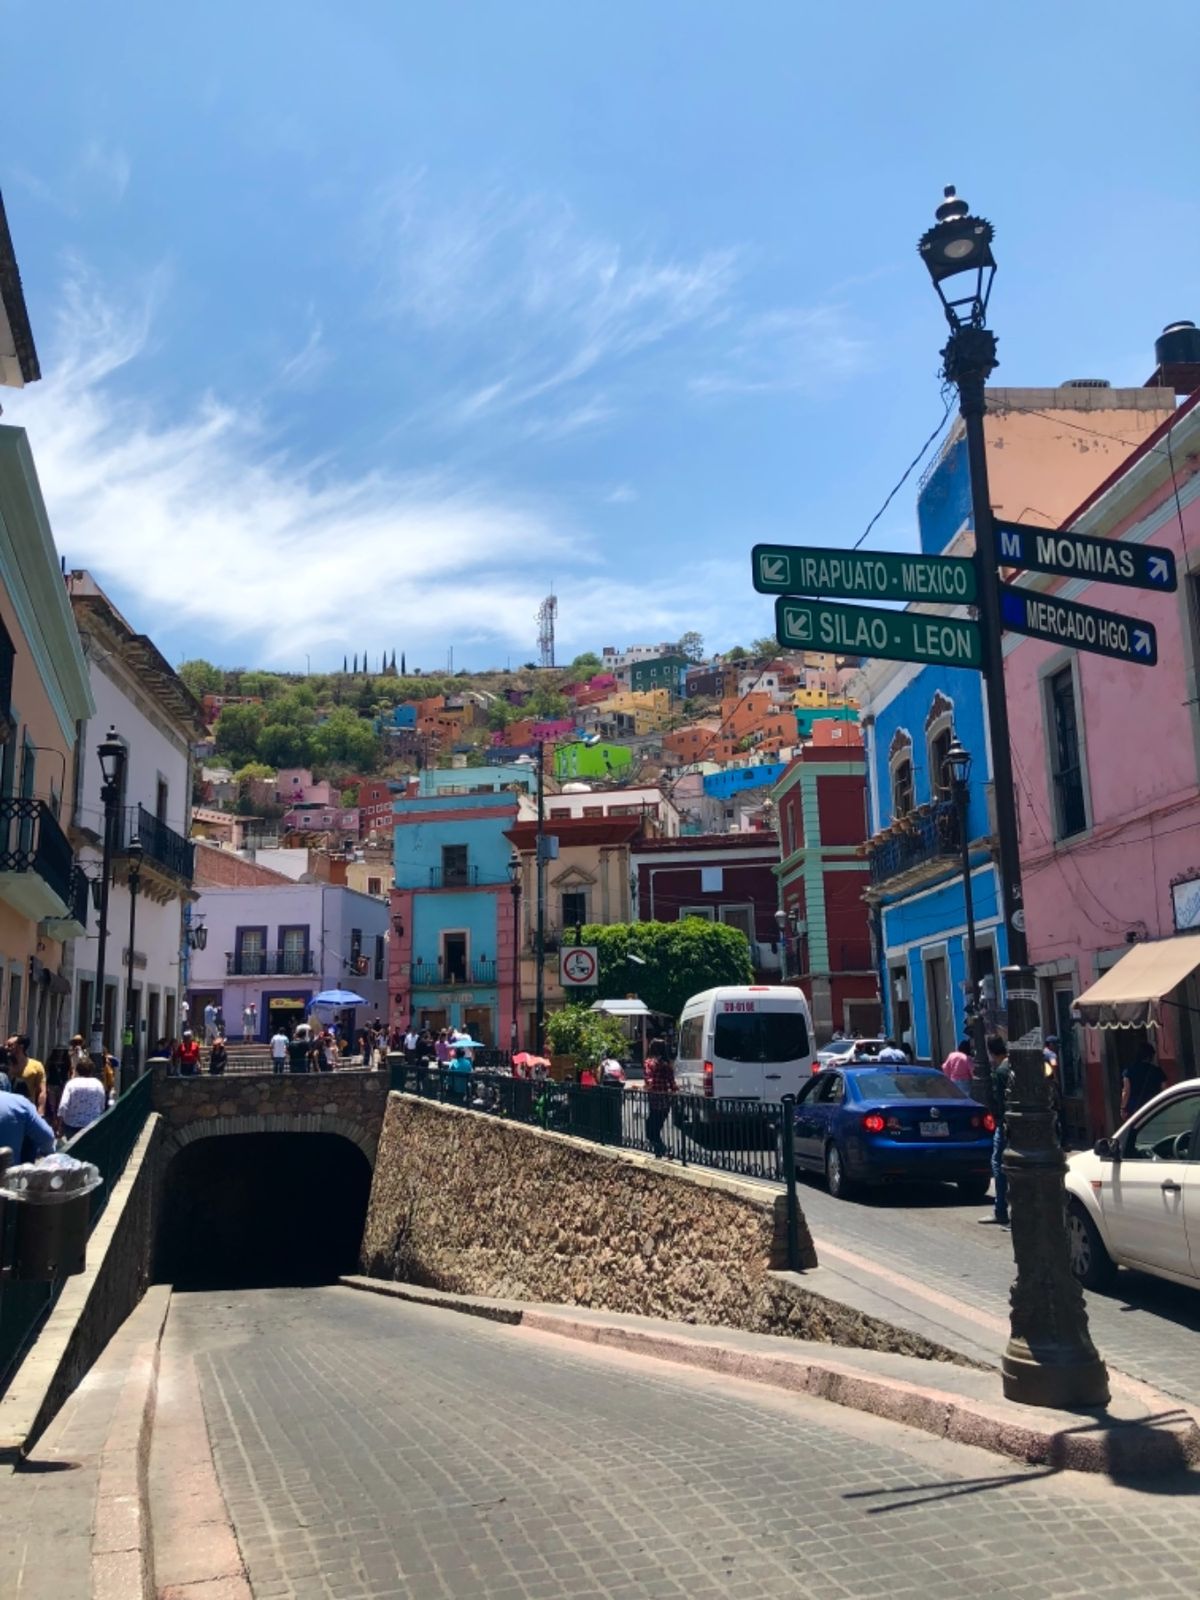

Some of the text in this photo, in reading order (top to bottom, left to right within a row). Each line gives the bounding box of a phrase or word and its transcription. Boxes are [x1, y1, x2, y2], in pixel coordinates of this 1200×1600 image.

[800, 557, 887, 591] IRAPUATO
[902, 563, 967, 595] MEXICO
[1036, 535, 1135, 578] MOMIAS
[820, 612, 887, 650] SILAO
[913, 623, 972, 659] LEON
[1026, 600, 1131, 653] MERCADO HGO.
